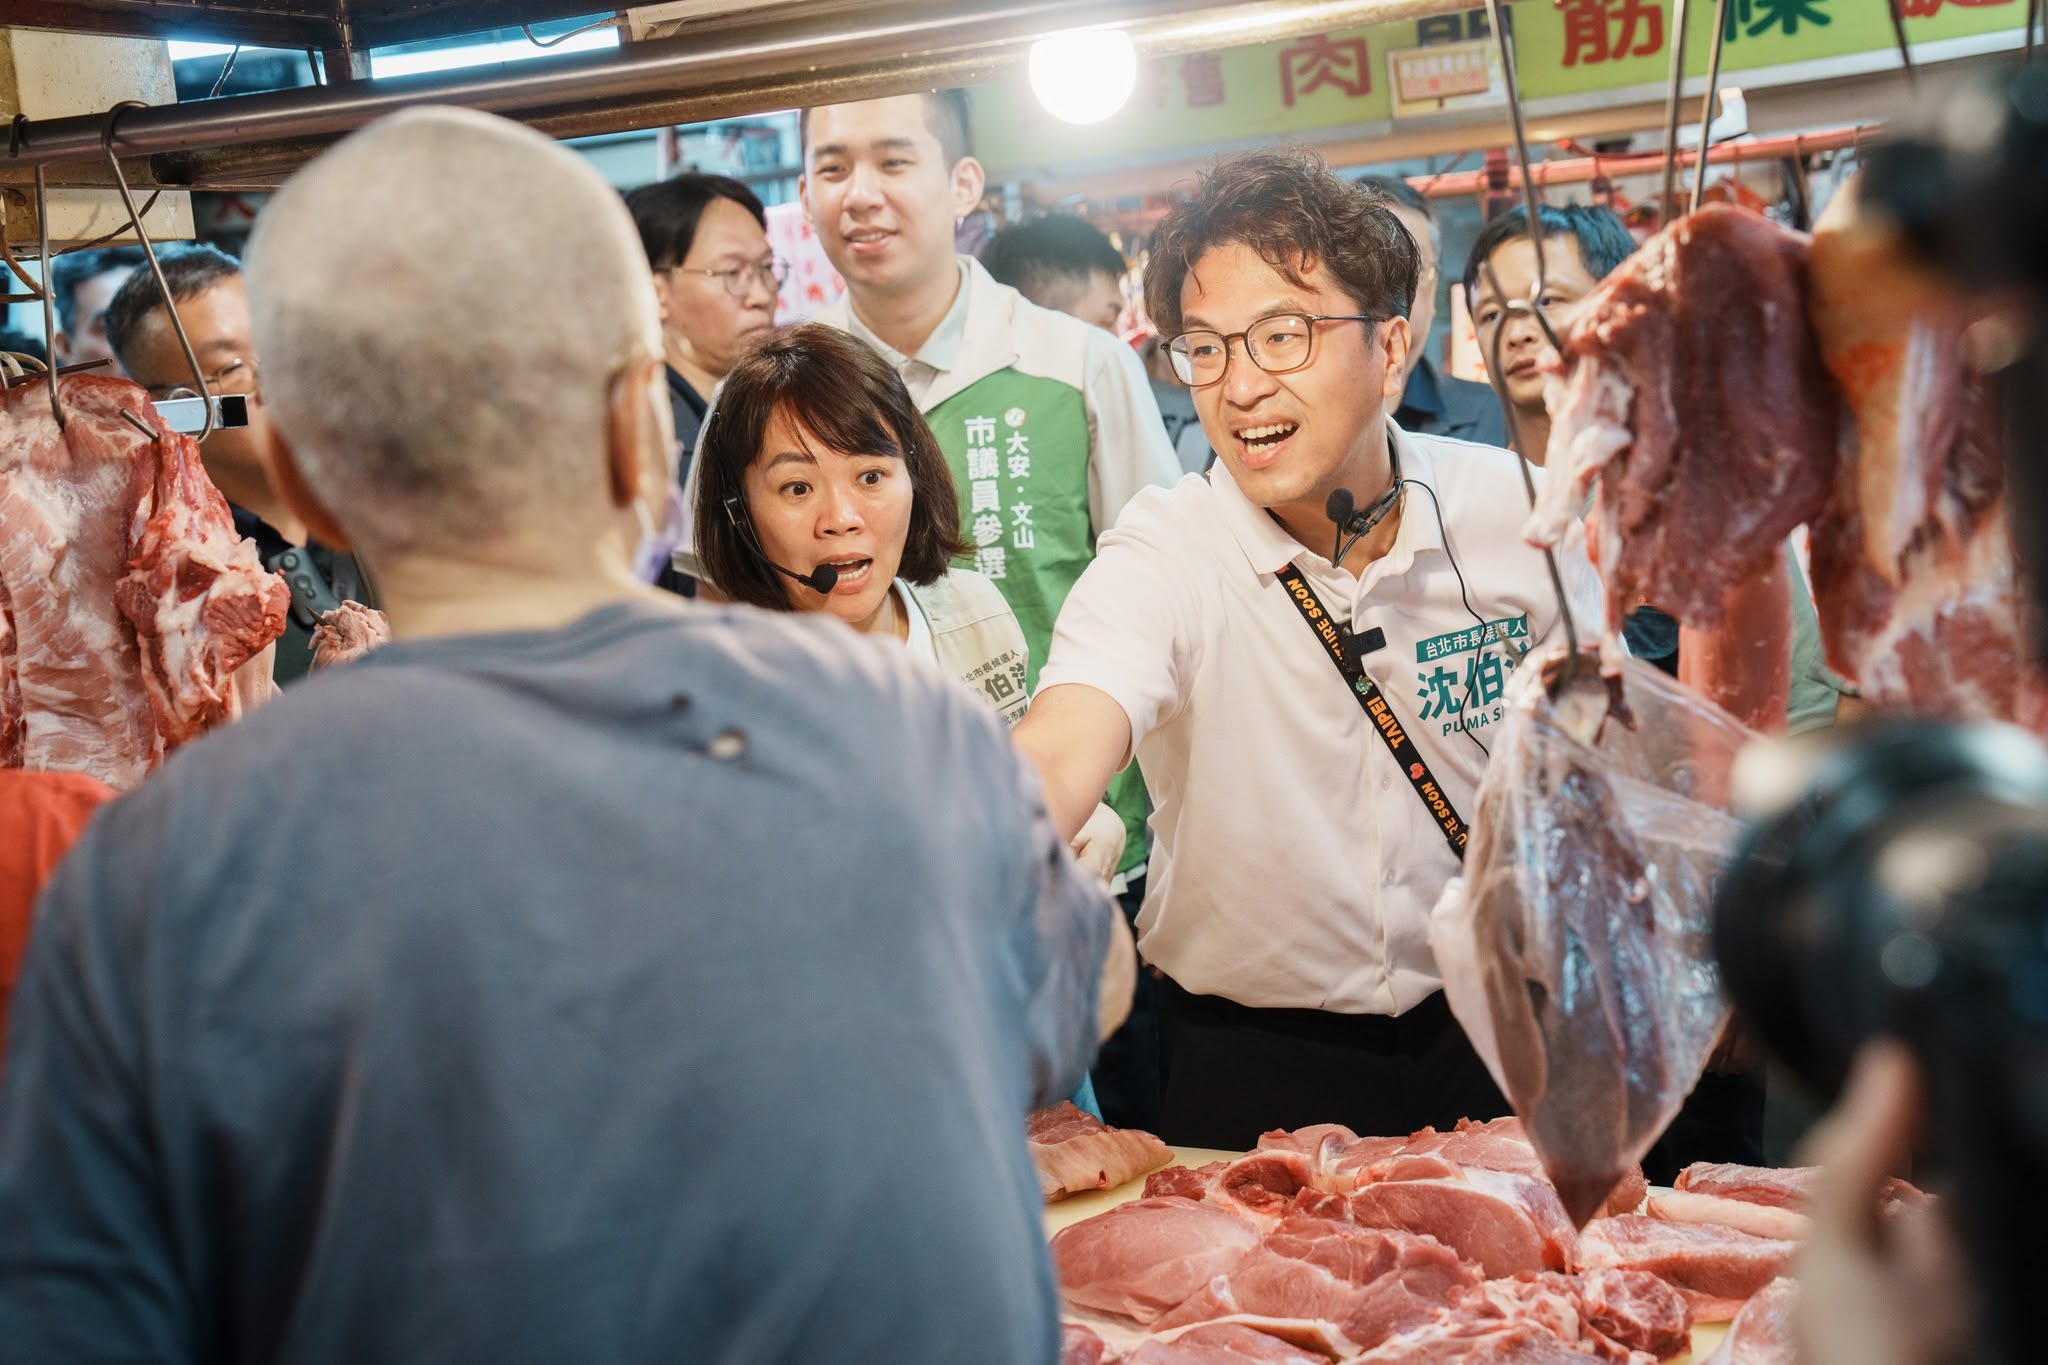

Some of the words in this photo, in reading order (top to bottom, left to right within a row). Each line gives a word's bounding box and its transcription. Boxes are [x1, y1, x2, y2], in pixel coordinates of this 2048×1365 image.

[964, 415, 1007, 579] 市議員參選
[1287, 578, 1322, 619] SOON
[1425, 619, 1527, 659] 台北市長候選人
[961, 649, 1019, 682] 北市長候選人
[1417, 641, 1527, 721] 沈伯
[1366, 695, 1405, 749] TAIPEI
[1442, 712, 1489, 737] PUMA
[1493, 705, 1504, 722] S
[1421, 781, 1450, 819] SOON
[1444, 817, 1468, 848] URE
